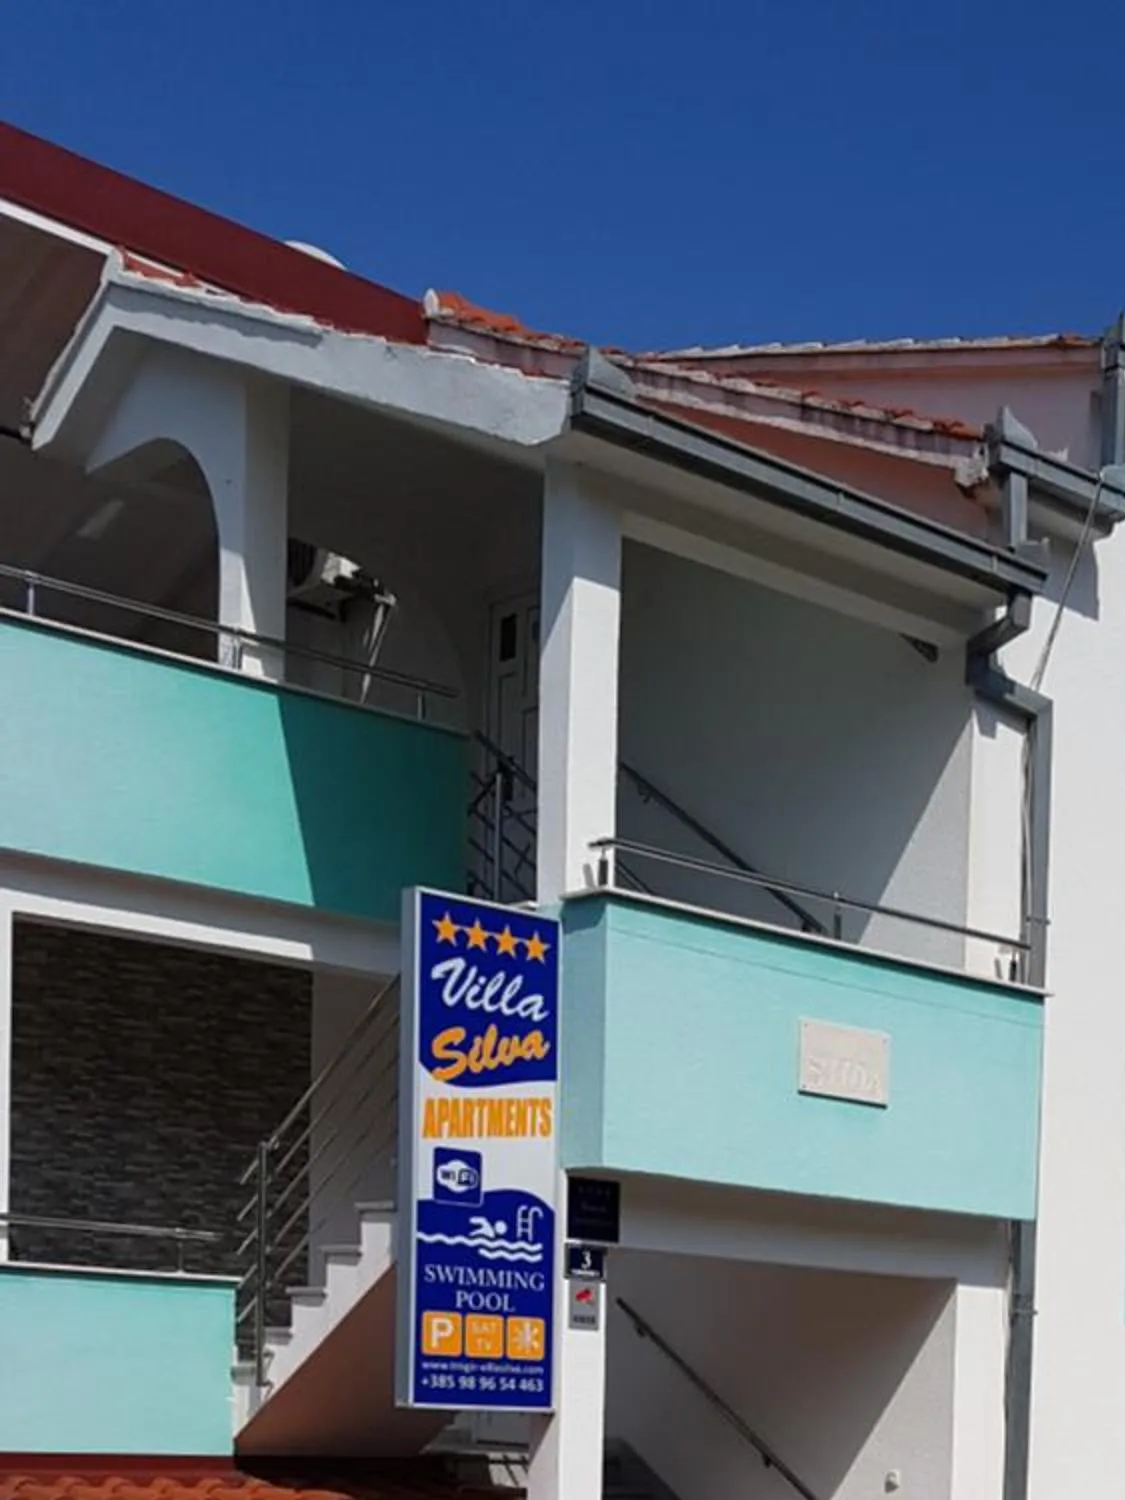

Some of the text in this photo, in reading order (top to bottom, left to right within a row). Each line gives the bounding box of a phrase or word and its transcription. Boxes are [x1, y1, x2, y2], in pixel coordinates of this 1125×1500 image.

[431, 957, 549, 1021] Villa
[431, 1023, 550, 1081] Silva
[422, 1098, 552, 1138] APARTMENTS
[424, 1264, 545, 1292] SWIMMING
[456, 1290, 516, 1312] POOL
[431, 1318, 453, 1348] P
